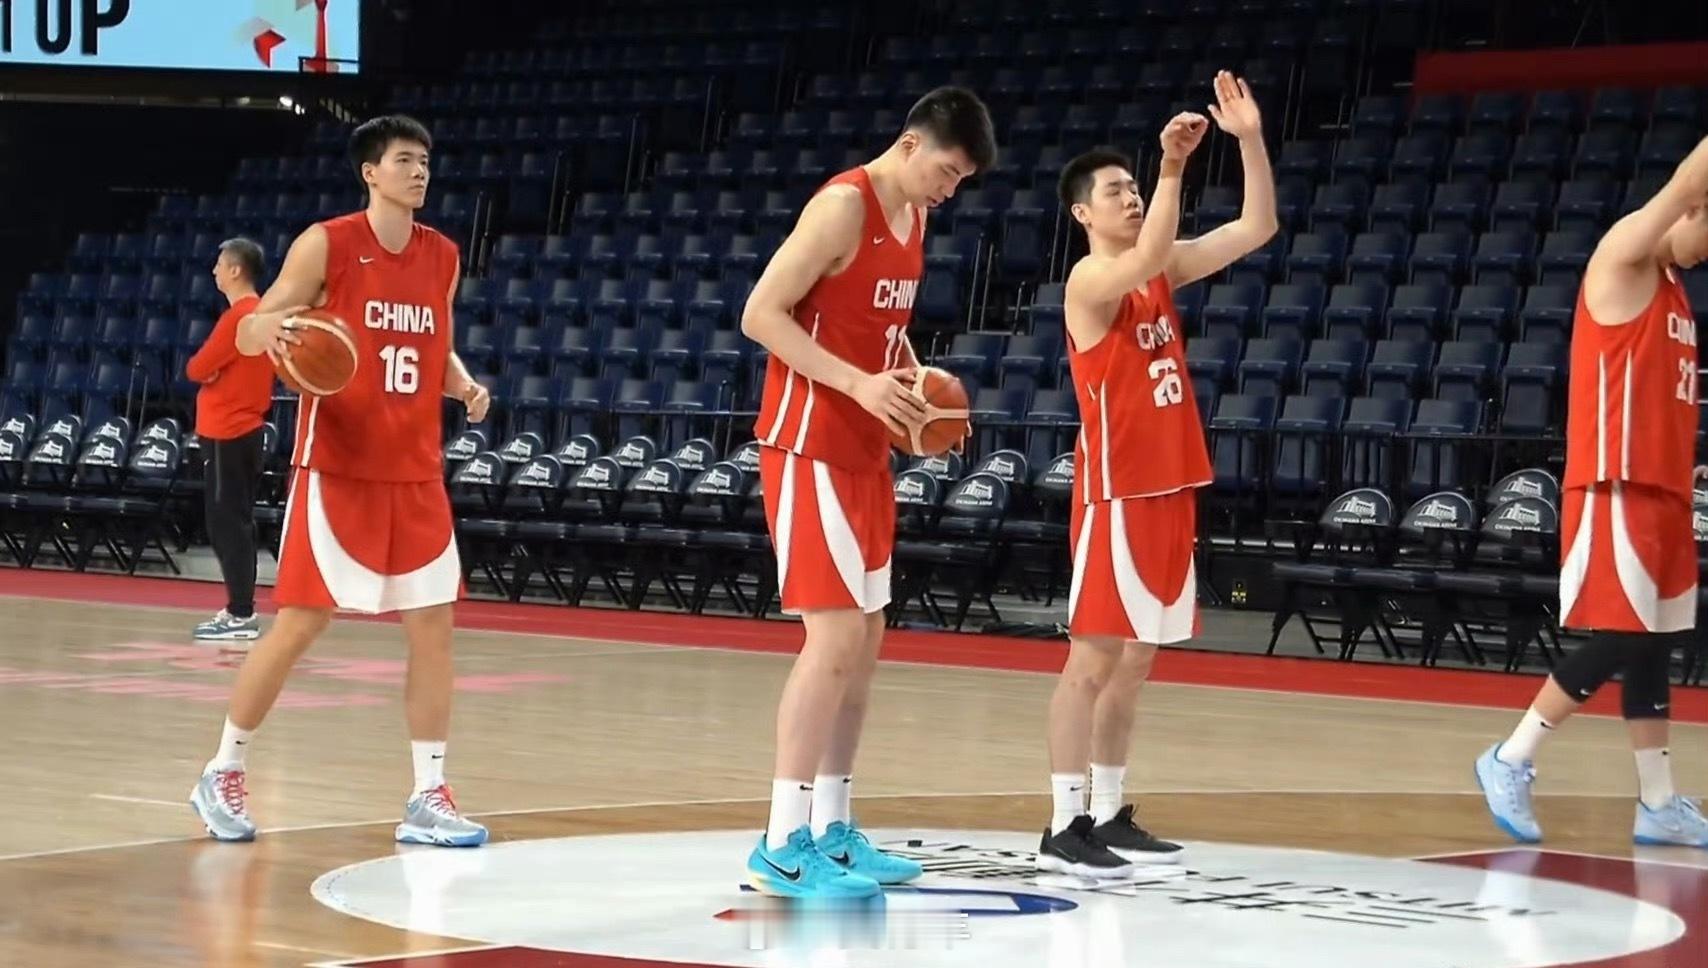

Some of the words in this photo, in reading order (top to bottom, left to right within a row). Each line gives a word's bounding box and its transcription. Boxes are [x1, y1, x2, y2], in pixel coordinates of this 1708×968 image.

[35, 0, 130, 55] UP
[364, 300, 435, 335] CHINA
[872, 278, 919, 310] CHIN
[378, 345, 420, 394] 16
[1148, 357, 1184, 407] 26
